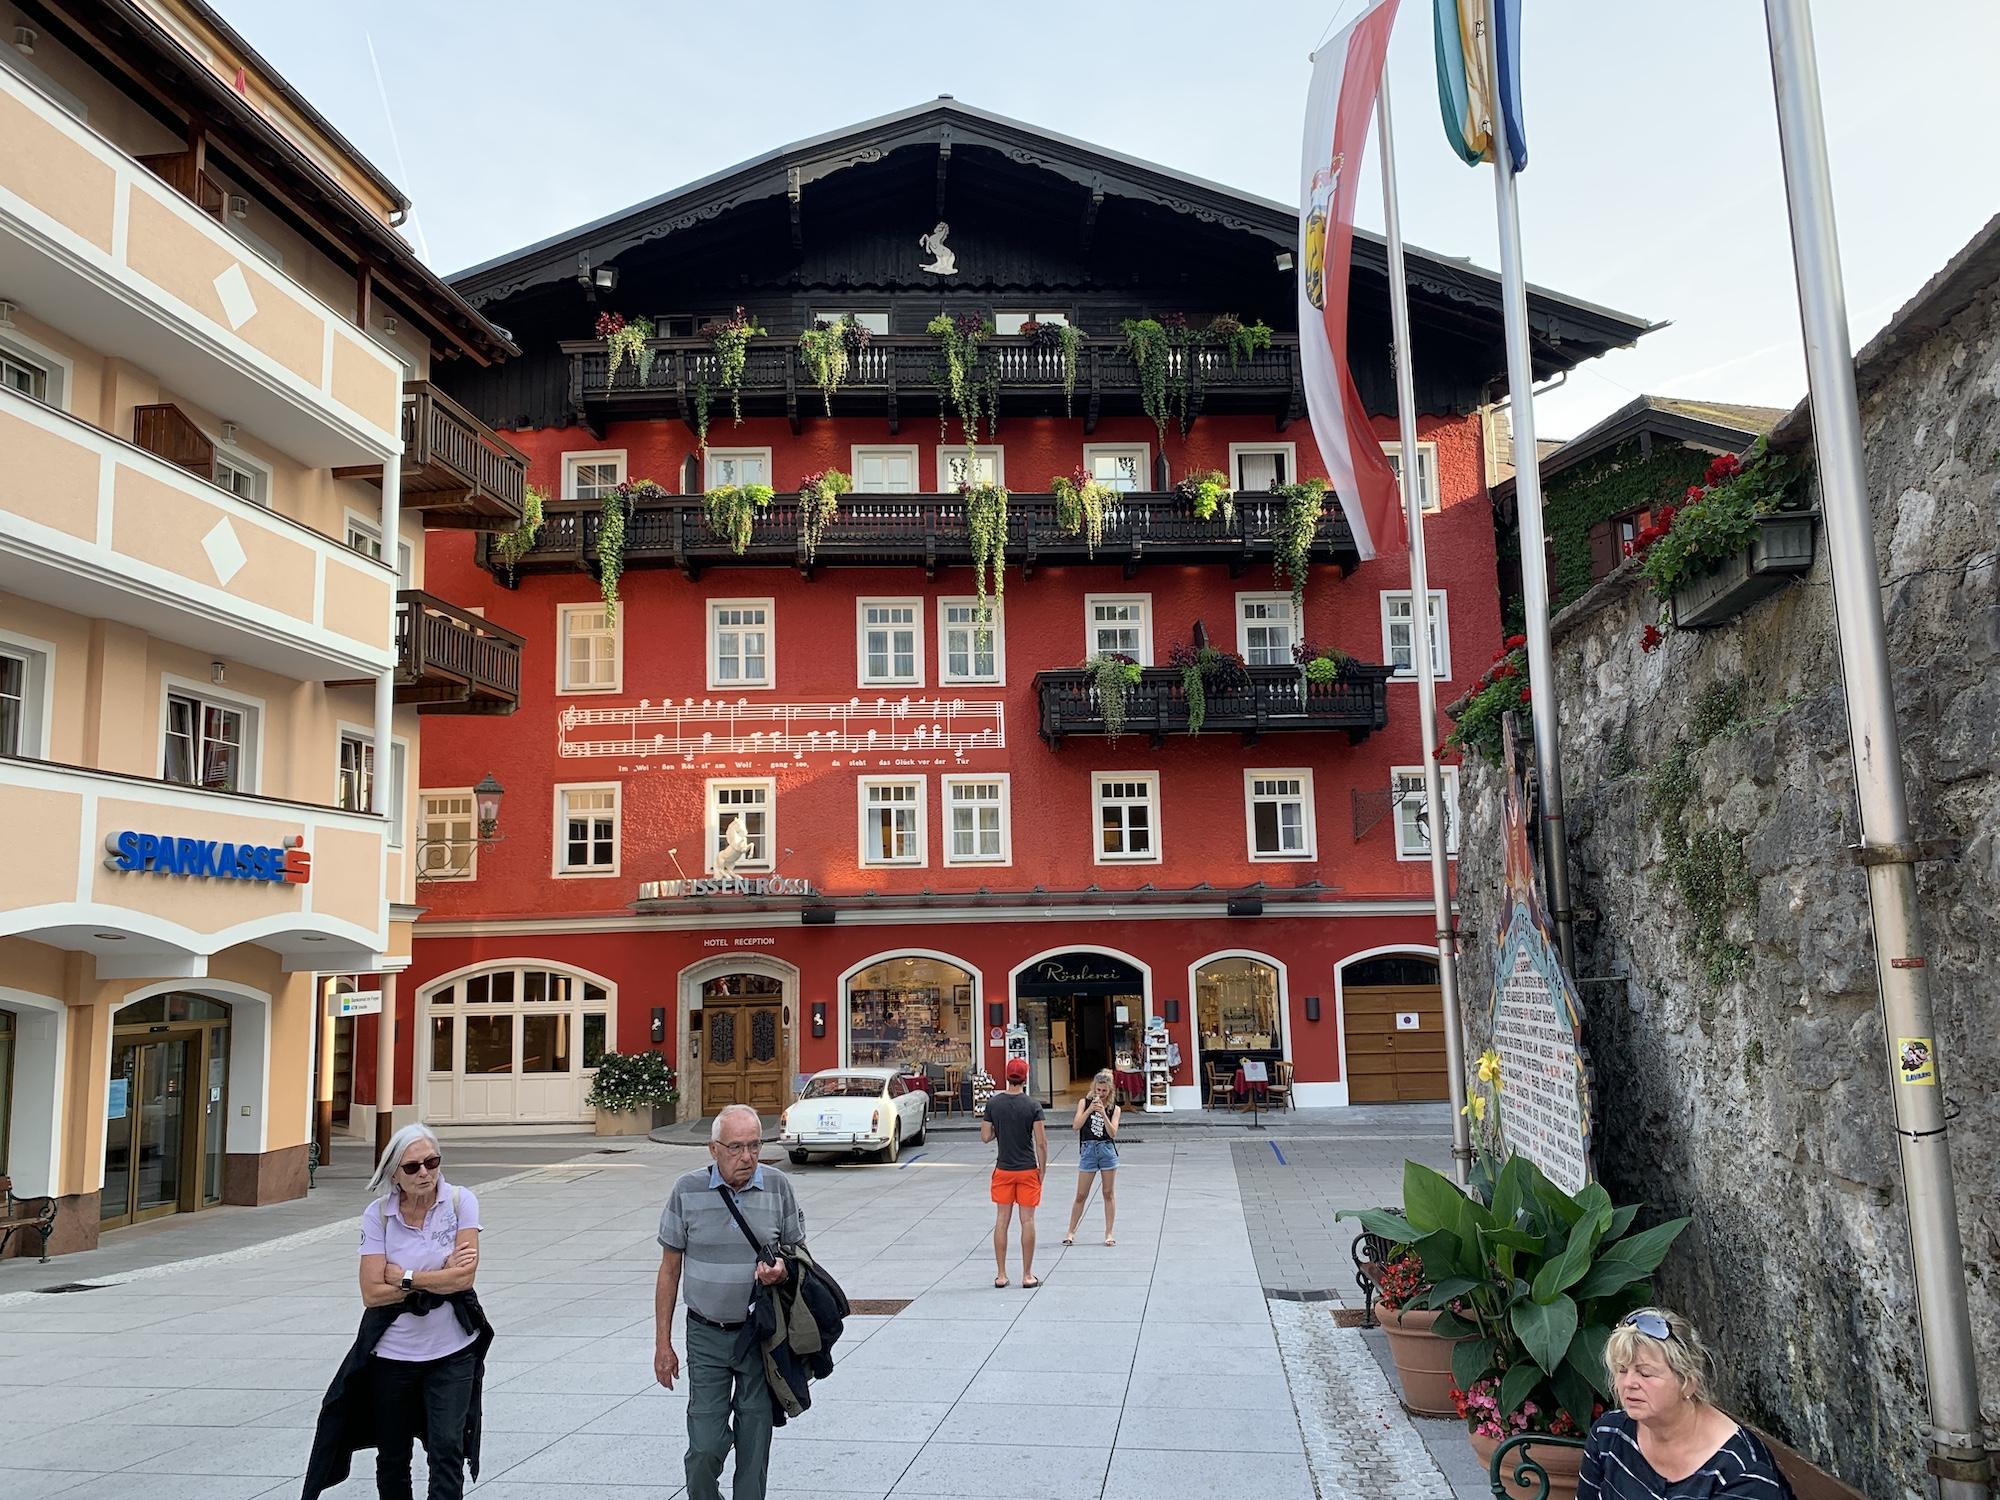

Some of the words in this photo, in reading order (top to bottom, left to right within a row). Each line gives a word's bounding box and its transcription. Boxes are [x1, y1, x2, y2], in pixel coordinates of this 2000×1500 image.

[734, 761, 753, 769] Wolf
[831, 759, 841, 767] da
[848, 759, 867, 767] steht
[894, 758, 916, 766] Glück
[955, 757, 970, 765] Tür
[114, 831, 285, 883] SPARKASSE
[659, 877, 750, 897] WEISSEN
[755, 874, 817, 897] RÖSSL
[703, 938, 729, 947] HOTEL
[734, 937, 775, 946] RECEPTION
[1037, 961, 1121, 982] Rösslerei
